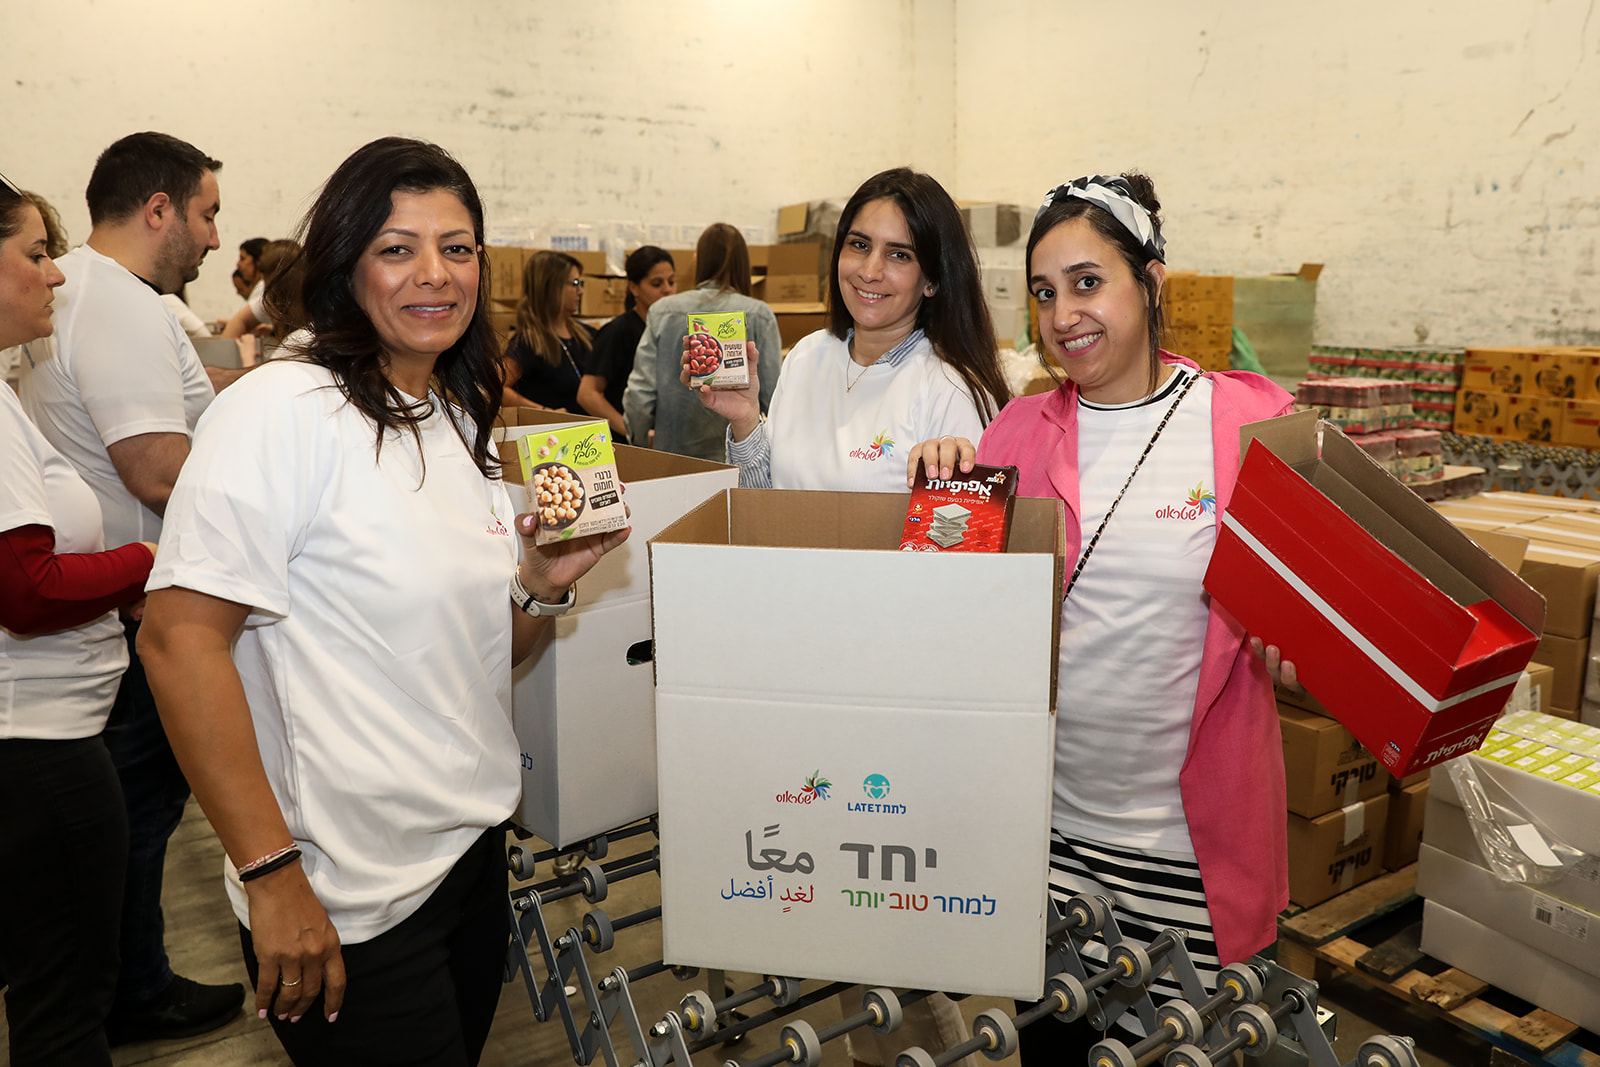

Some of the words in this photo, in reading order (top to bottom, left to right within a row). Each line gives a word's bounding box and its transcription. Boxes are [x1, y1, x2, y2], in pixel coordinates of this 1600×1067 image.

[849, 447, 881, 462] שטראוס
[594, 470, 612, 480] גרגרי
[593, 480, 614, 492] חומוס
[928, 494, 947, 502] שוקולד
[1155, 504, 1200, 521] שטראוס
[1330, 761, 1377, 796] טורקי
[776, 790, 814, 805] שטראוס
[847, 802, 882, 813] LATET
[882, 804, 907, 815] לתת
[839, 842, 937, 883] יחד
[1328, 846, 1372, 885] טורקי
[720, 874, 774, 900] أفضل
[841, 889, 885, 909] יותר
[889, 893, 929, 912] טוב
[933, 894, 997, 916] למחר
